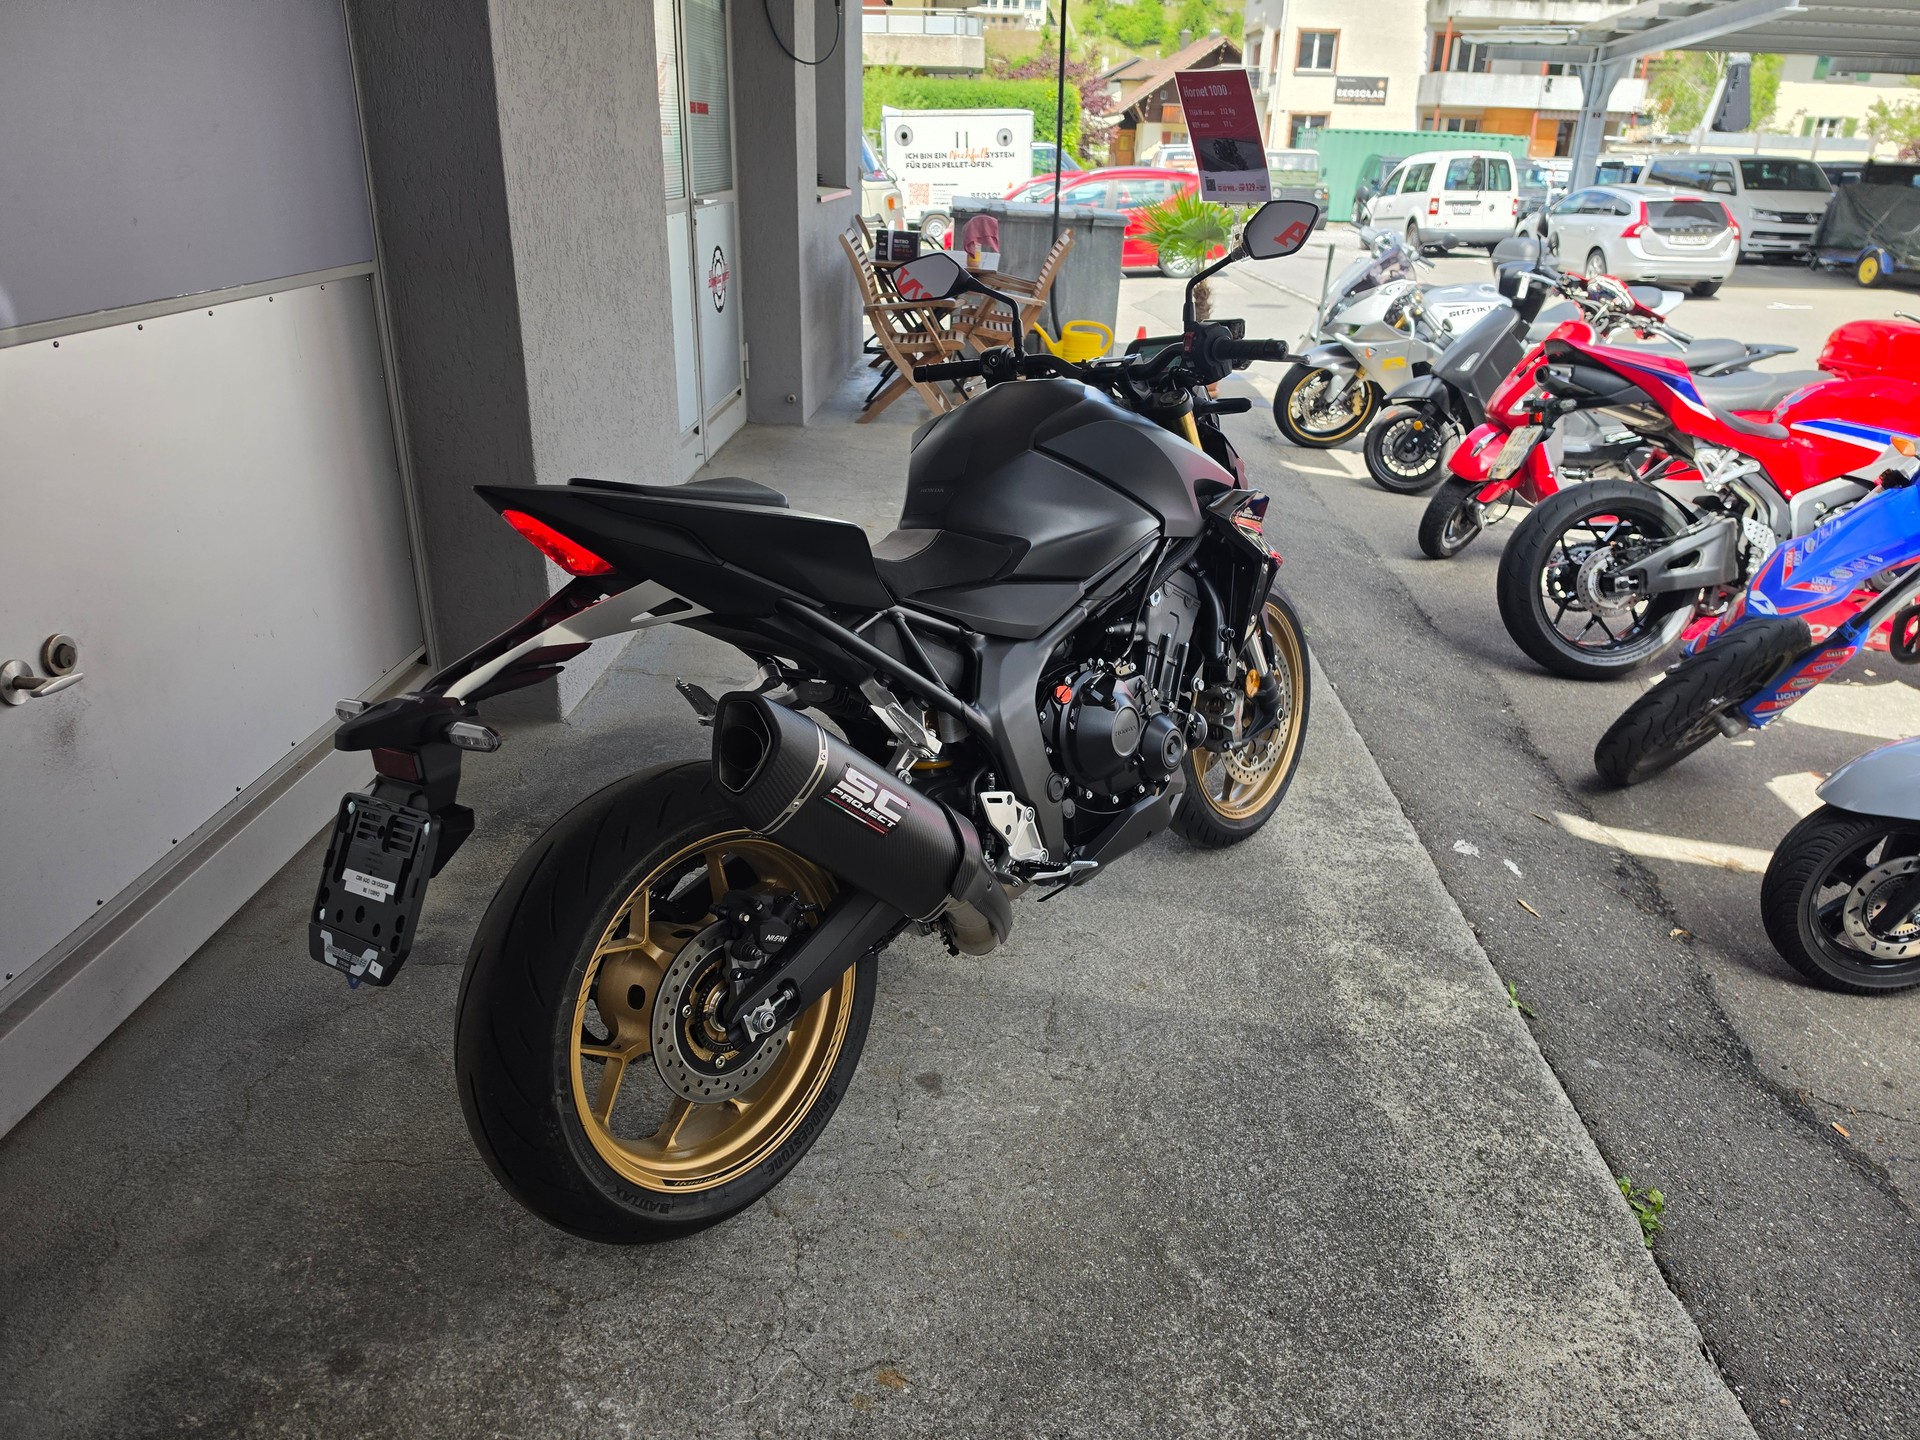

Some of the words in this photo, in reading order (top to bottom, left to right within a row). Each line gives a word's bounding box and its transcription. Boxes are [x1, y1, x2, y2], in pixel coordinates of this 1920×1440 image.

[1183, 85, 1208, 98] Hornet
[1208, 84, 1228, 97] 1000
[906, 160, 921, 169] FÜR
[922, 161, 940, 169] DEIN
[1449, 305, 1491, 318] SUZUKI
[1811, 577, 1833, 586] LIQUI
[1809, 584, 1832, 593] MOLY
[1775, 691, 1801, 701] LIQUI
[1115, 725, 1137, 737] HONDA
[836, 767, 907, 823] SC
[830, 787, 897, 828] PROJECT
[766, 1088, 838, 1176] BRIDGESTONE
